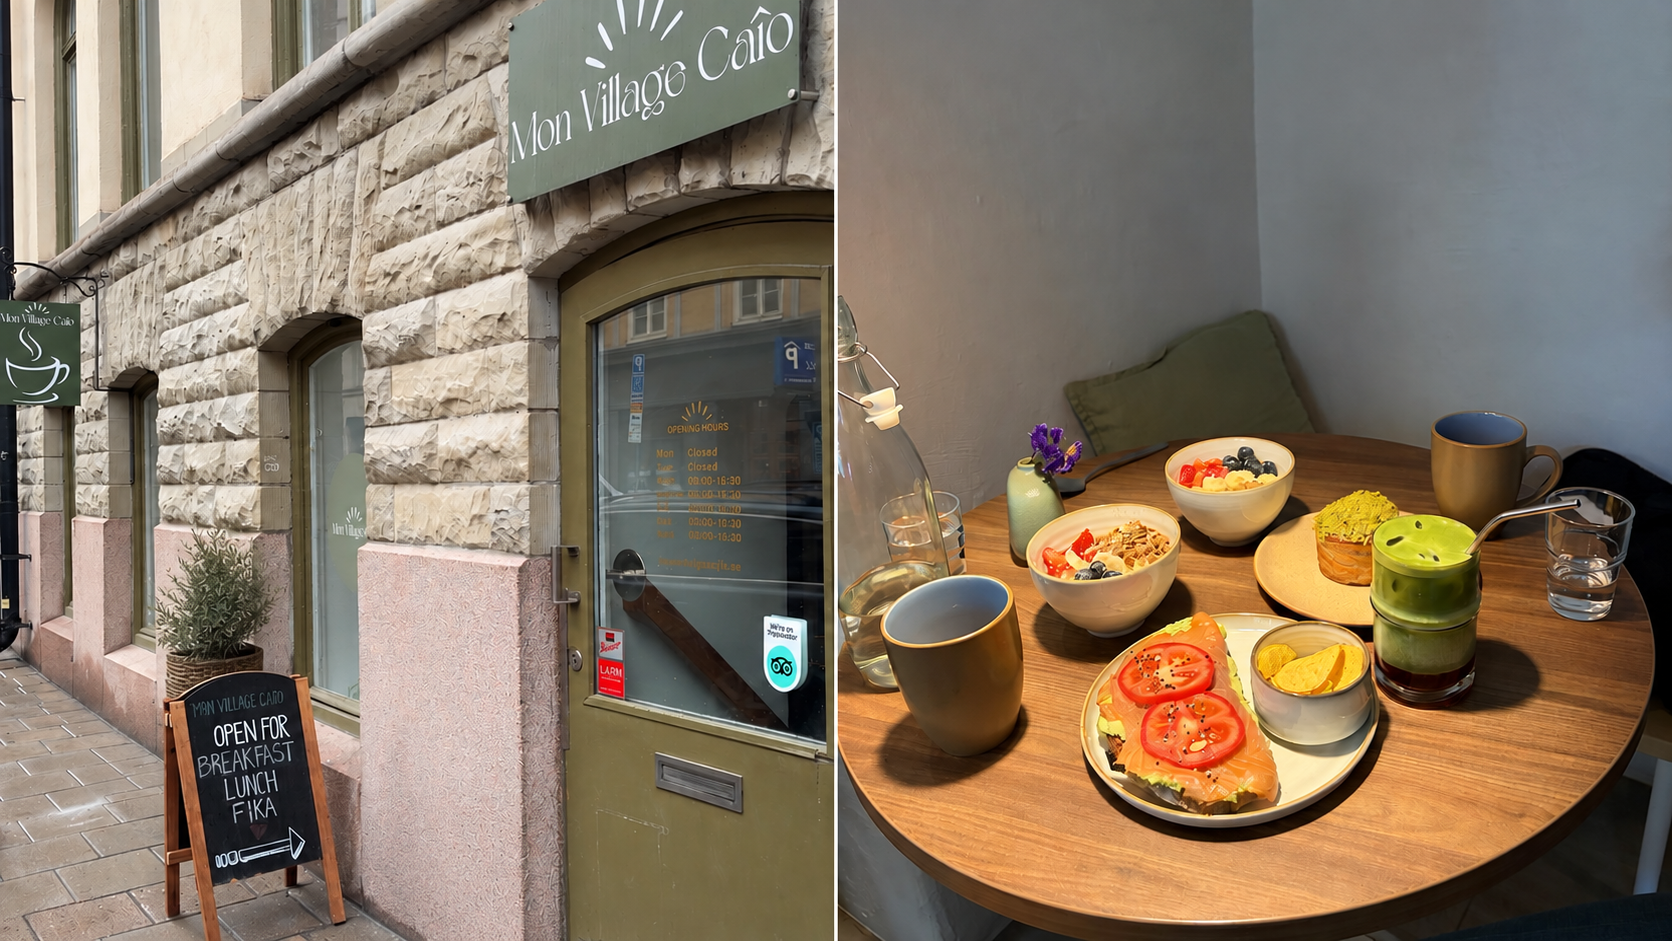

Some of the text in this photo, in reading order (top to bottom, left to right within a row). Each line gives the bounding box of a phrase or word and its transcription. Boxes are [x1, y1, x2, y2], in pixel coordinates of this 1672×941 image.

[511, 6, 794, 164] Mon Village Caîo
[0, 313, 20, 324] Mon
[22, 314, 51, 327] Village
[667, 422, 729, 434] OPENING HOURS
[656, 447, 718, 458] Mon Closed
[687, 462, 718, 471] Closed
[600, 665, 623, 677] LARM
[217, 693, 257, 713] VILLAGE
[213, 714, 291, 747] OPEN FOR
[197, 741, 295, 779] BREAKFAST
[224, 769, 279, 801] LUNCH
[232, 797, 277, 824] FIKA
